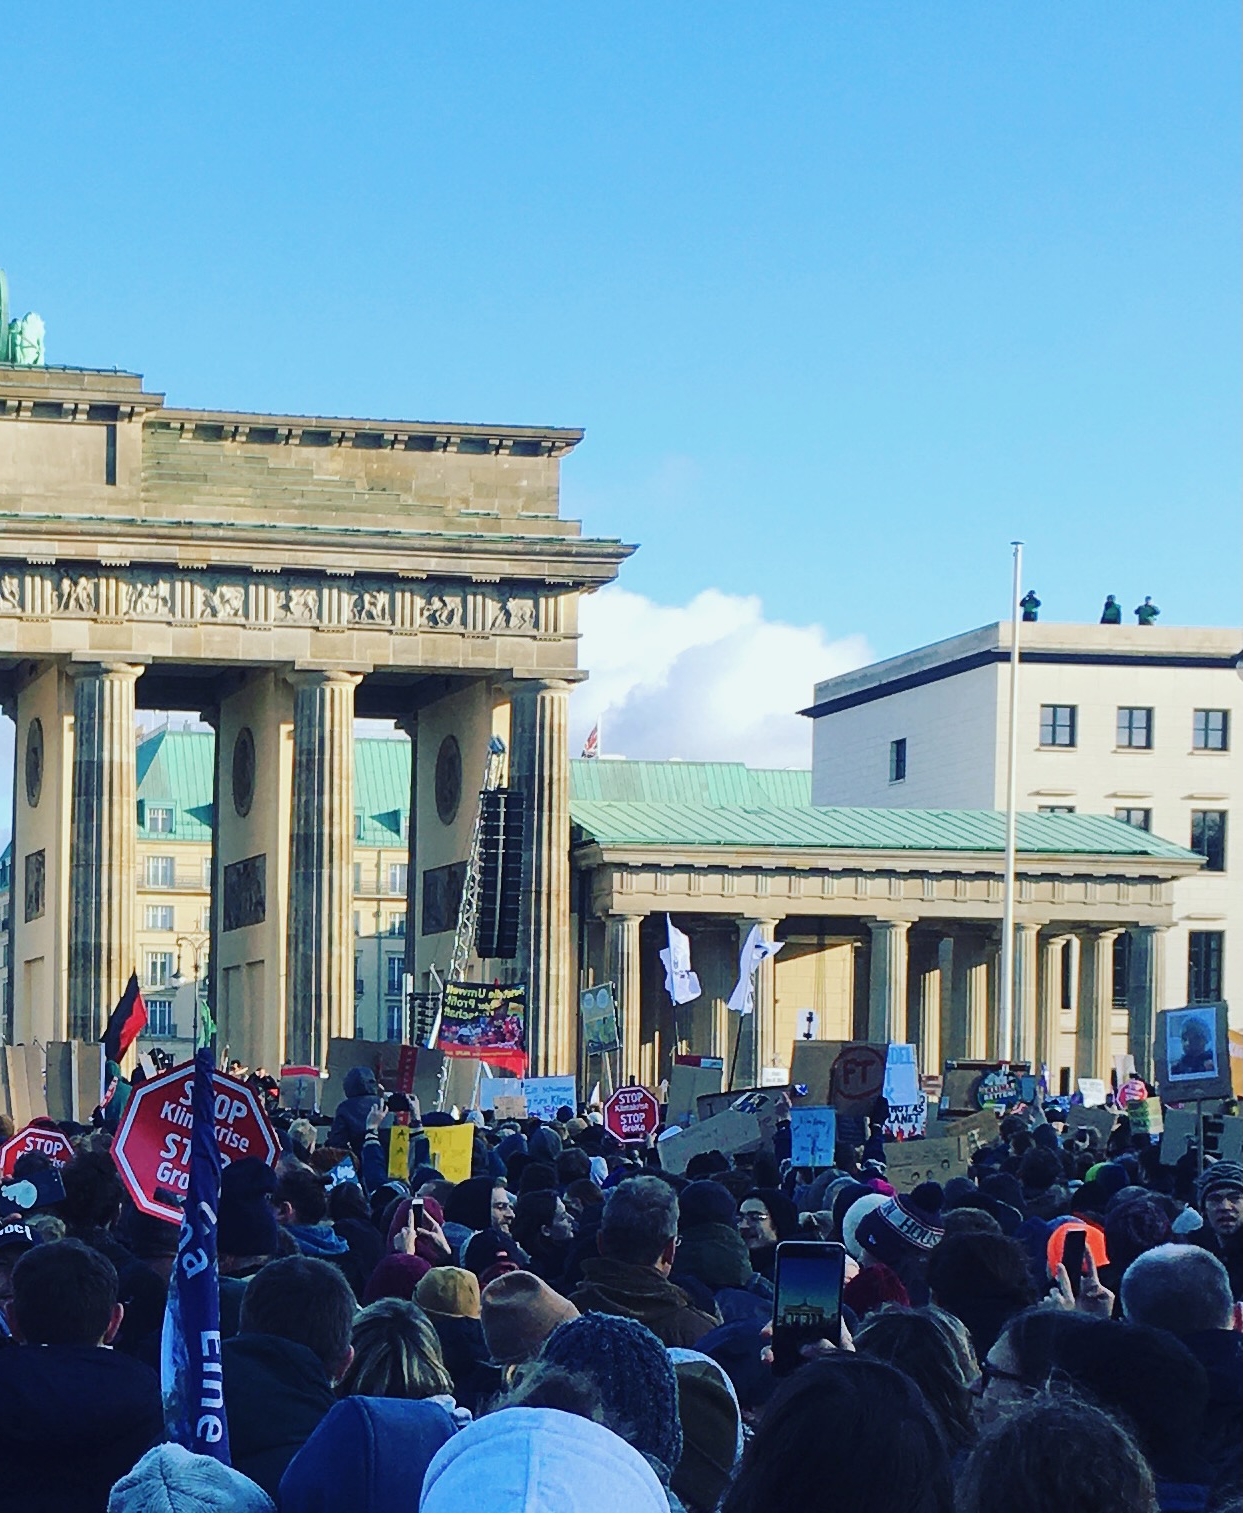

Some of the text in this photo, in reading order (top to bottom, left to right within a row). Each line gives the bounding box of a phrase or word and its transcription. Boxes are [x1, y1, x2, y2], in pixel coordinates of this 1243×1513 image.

[179, 1080, 248, 1125] SOP
[618, 1092, 644, 1105] STOP
[160, 1101, 250, 1153] Klimkrise
[620, 1112, 646, 1125] STOP
[24, 1136, 64, 1156] STOP
[160, 1133, 232, 1170] STP
[156, 1161, 190, 1190] Gro
[899, 1217, 942, 1248] HOUS
